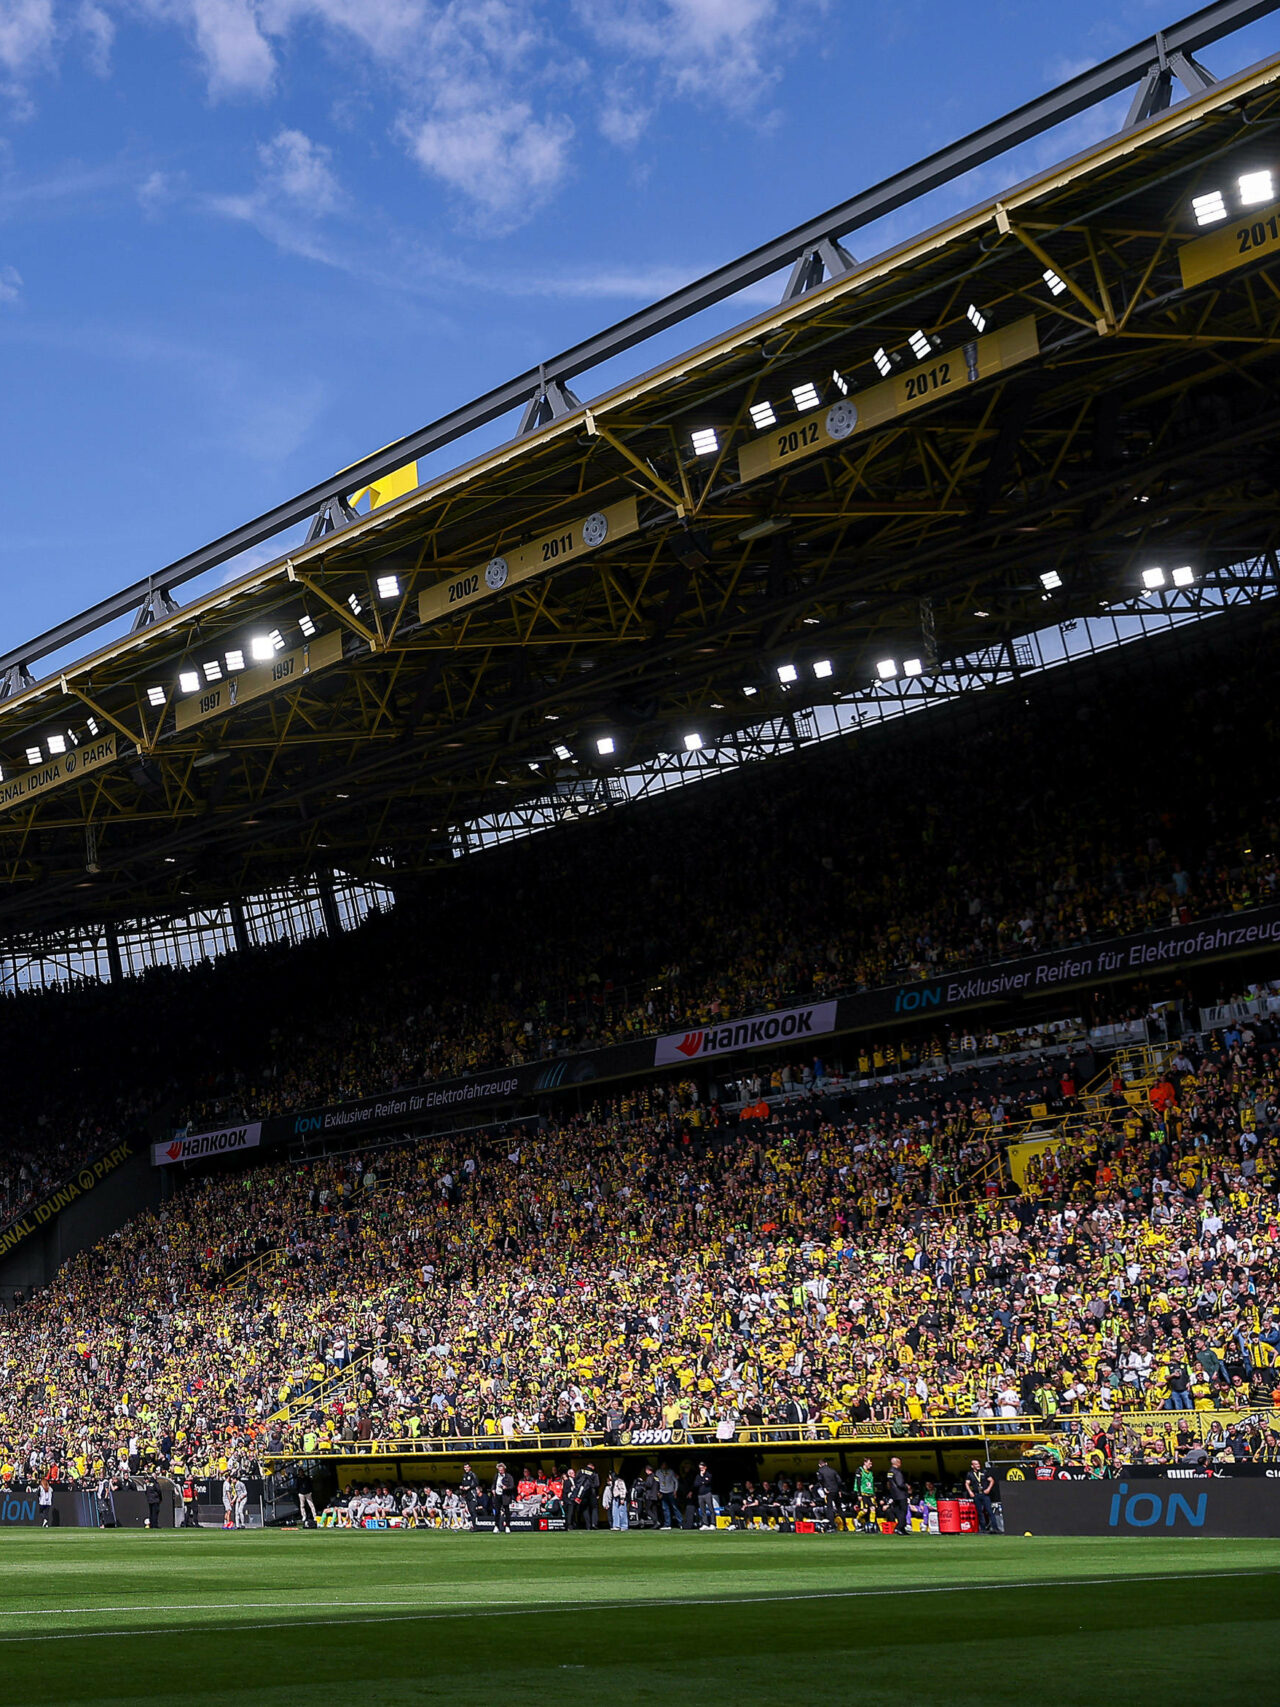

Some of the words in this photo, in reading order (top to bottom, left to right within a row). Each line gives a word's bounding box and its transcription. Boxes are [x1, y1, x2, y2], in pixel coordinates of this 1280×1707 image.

[1237, 212, 1280, 253] 201
[778, 422, 819, 456] 2012
[905, 363, 950, 400] 2012
[448, 575, 479, 602] 2002
[542, 533, 573, 561] 2011
[199, 691, 220, 713] 1997
[272, 657, 294, 681] 1997
[28, 766, 61, 791] IDUNA
[83, 740, 113, 766] PARK
[946, 971, 1032, 1002] Exklusiver
[1035, 958, 1092, 984] Reifen
[1096, 951, 1123, 973] für
[324, 1108, 373, 1129] Exklusiver
[374, 1099, 408, 1117] Reifen
[409, 1094, 424, 1111] für
[426, 1077, 518, 1108] Elektrofahrzeuge
[33, 1184, 82, 1224] IDUNA
[92, 1140, 134, 1179] PARK
[631, 1429, 671, 1444] 59590
